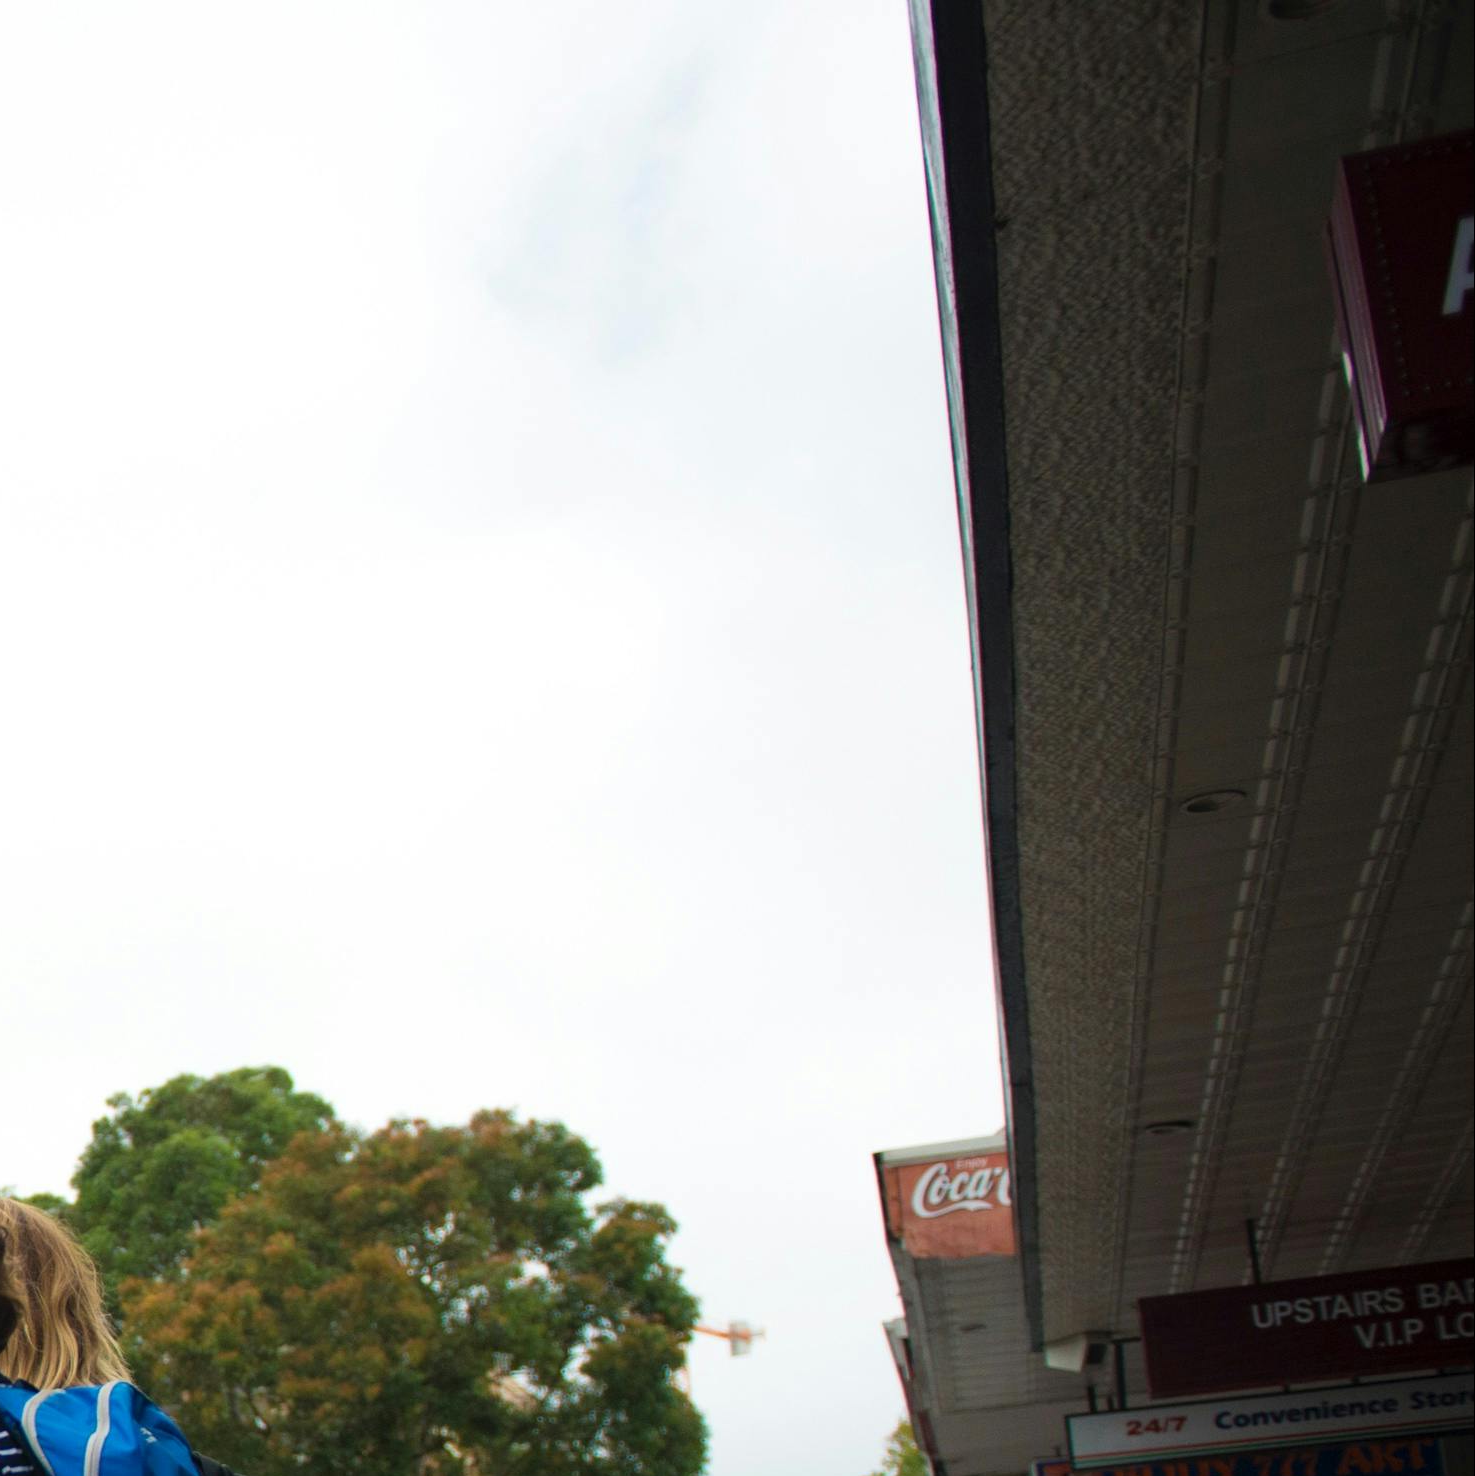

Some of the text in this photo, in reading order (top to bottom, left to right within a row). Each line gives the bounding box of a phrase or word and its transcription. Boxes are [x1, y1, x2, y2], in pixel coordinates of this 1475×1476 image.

[1253, 1287, 1405, 1328] UPSTAIRS
[1354, 1317, 1424, 1350] V.I.P
[1127, 1416, 1187, 1436] 24/7
[1214, 1397, 1399, 1429] Convenience
